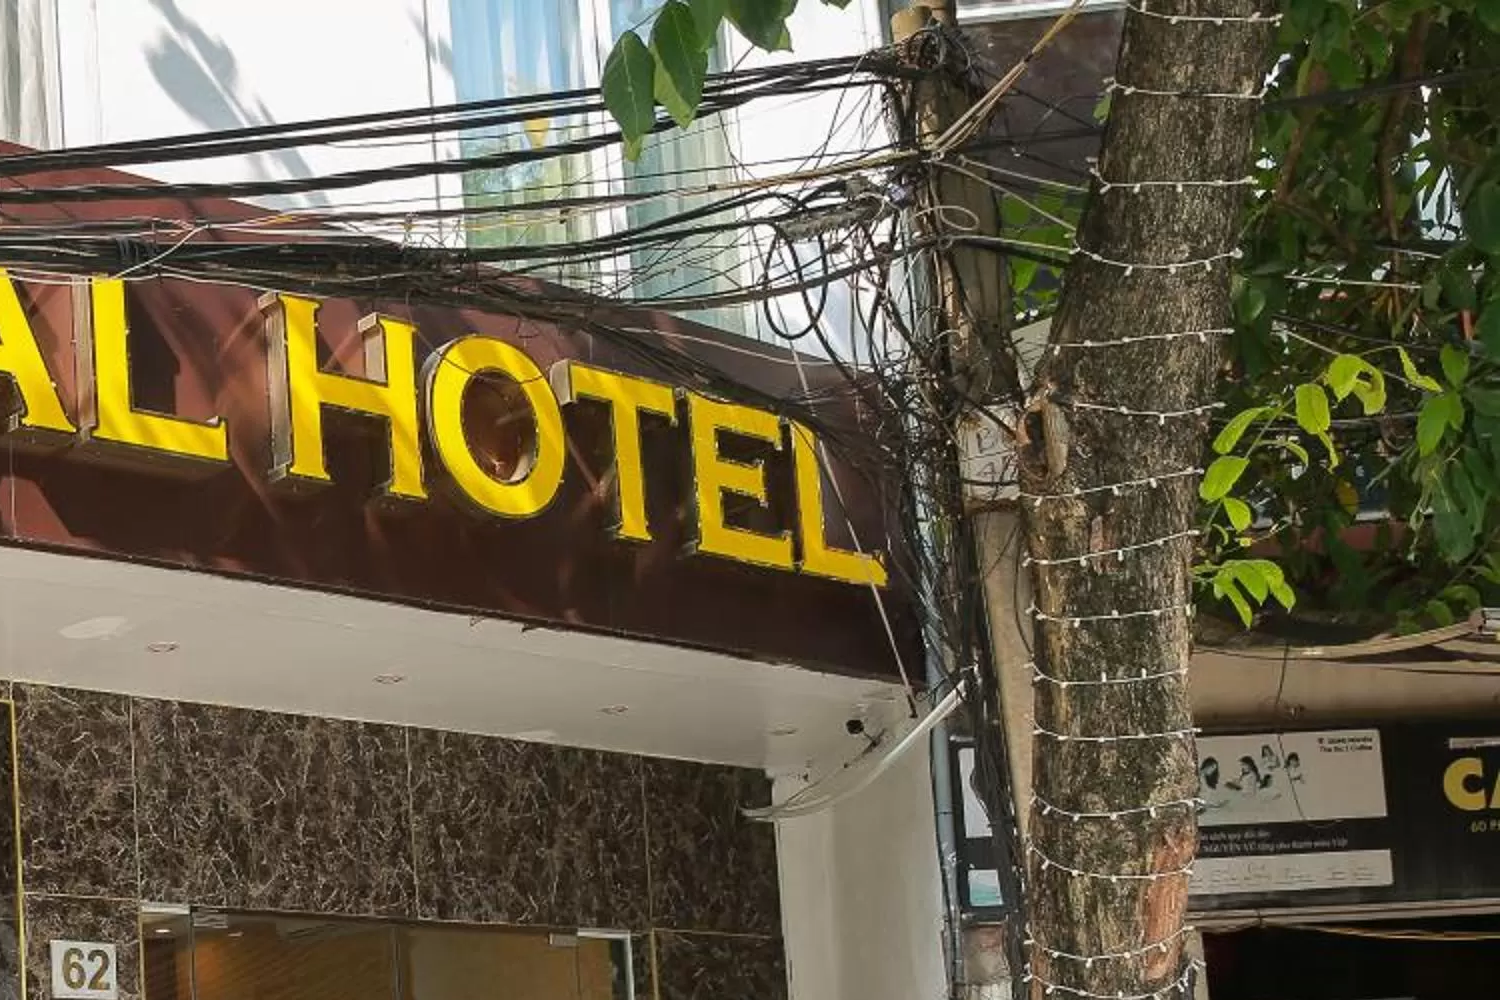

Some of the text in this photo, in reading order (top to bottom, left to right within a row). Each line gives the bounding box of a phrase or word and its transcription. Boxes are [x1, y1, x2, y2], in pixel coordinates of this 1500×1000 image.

[268, 291, 888, 588] HOTEL
[1443, 757, 1500, 811] C
[62, 947, 111, 991] 62
